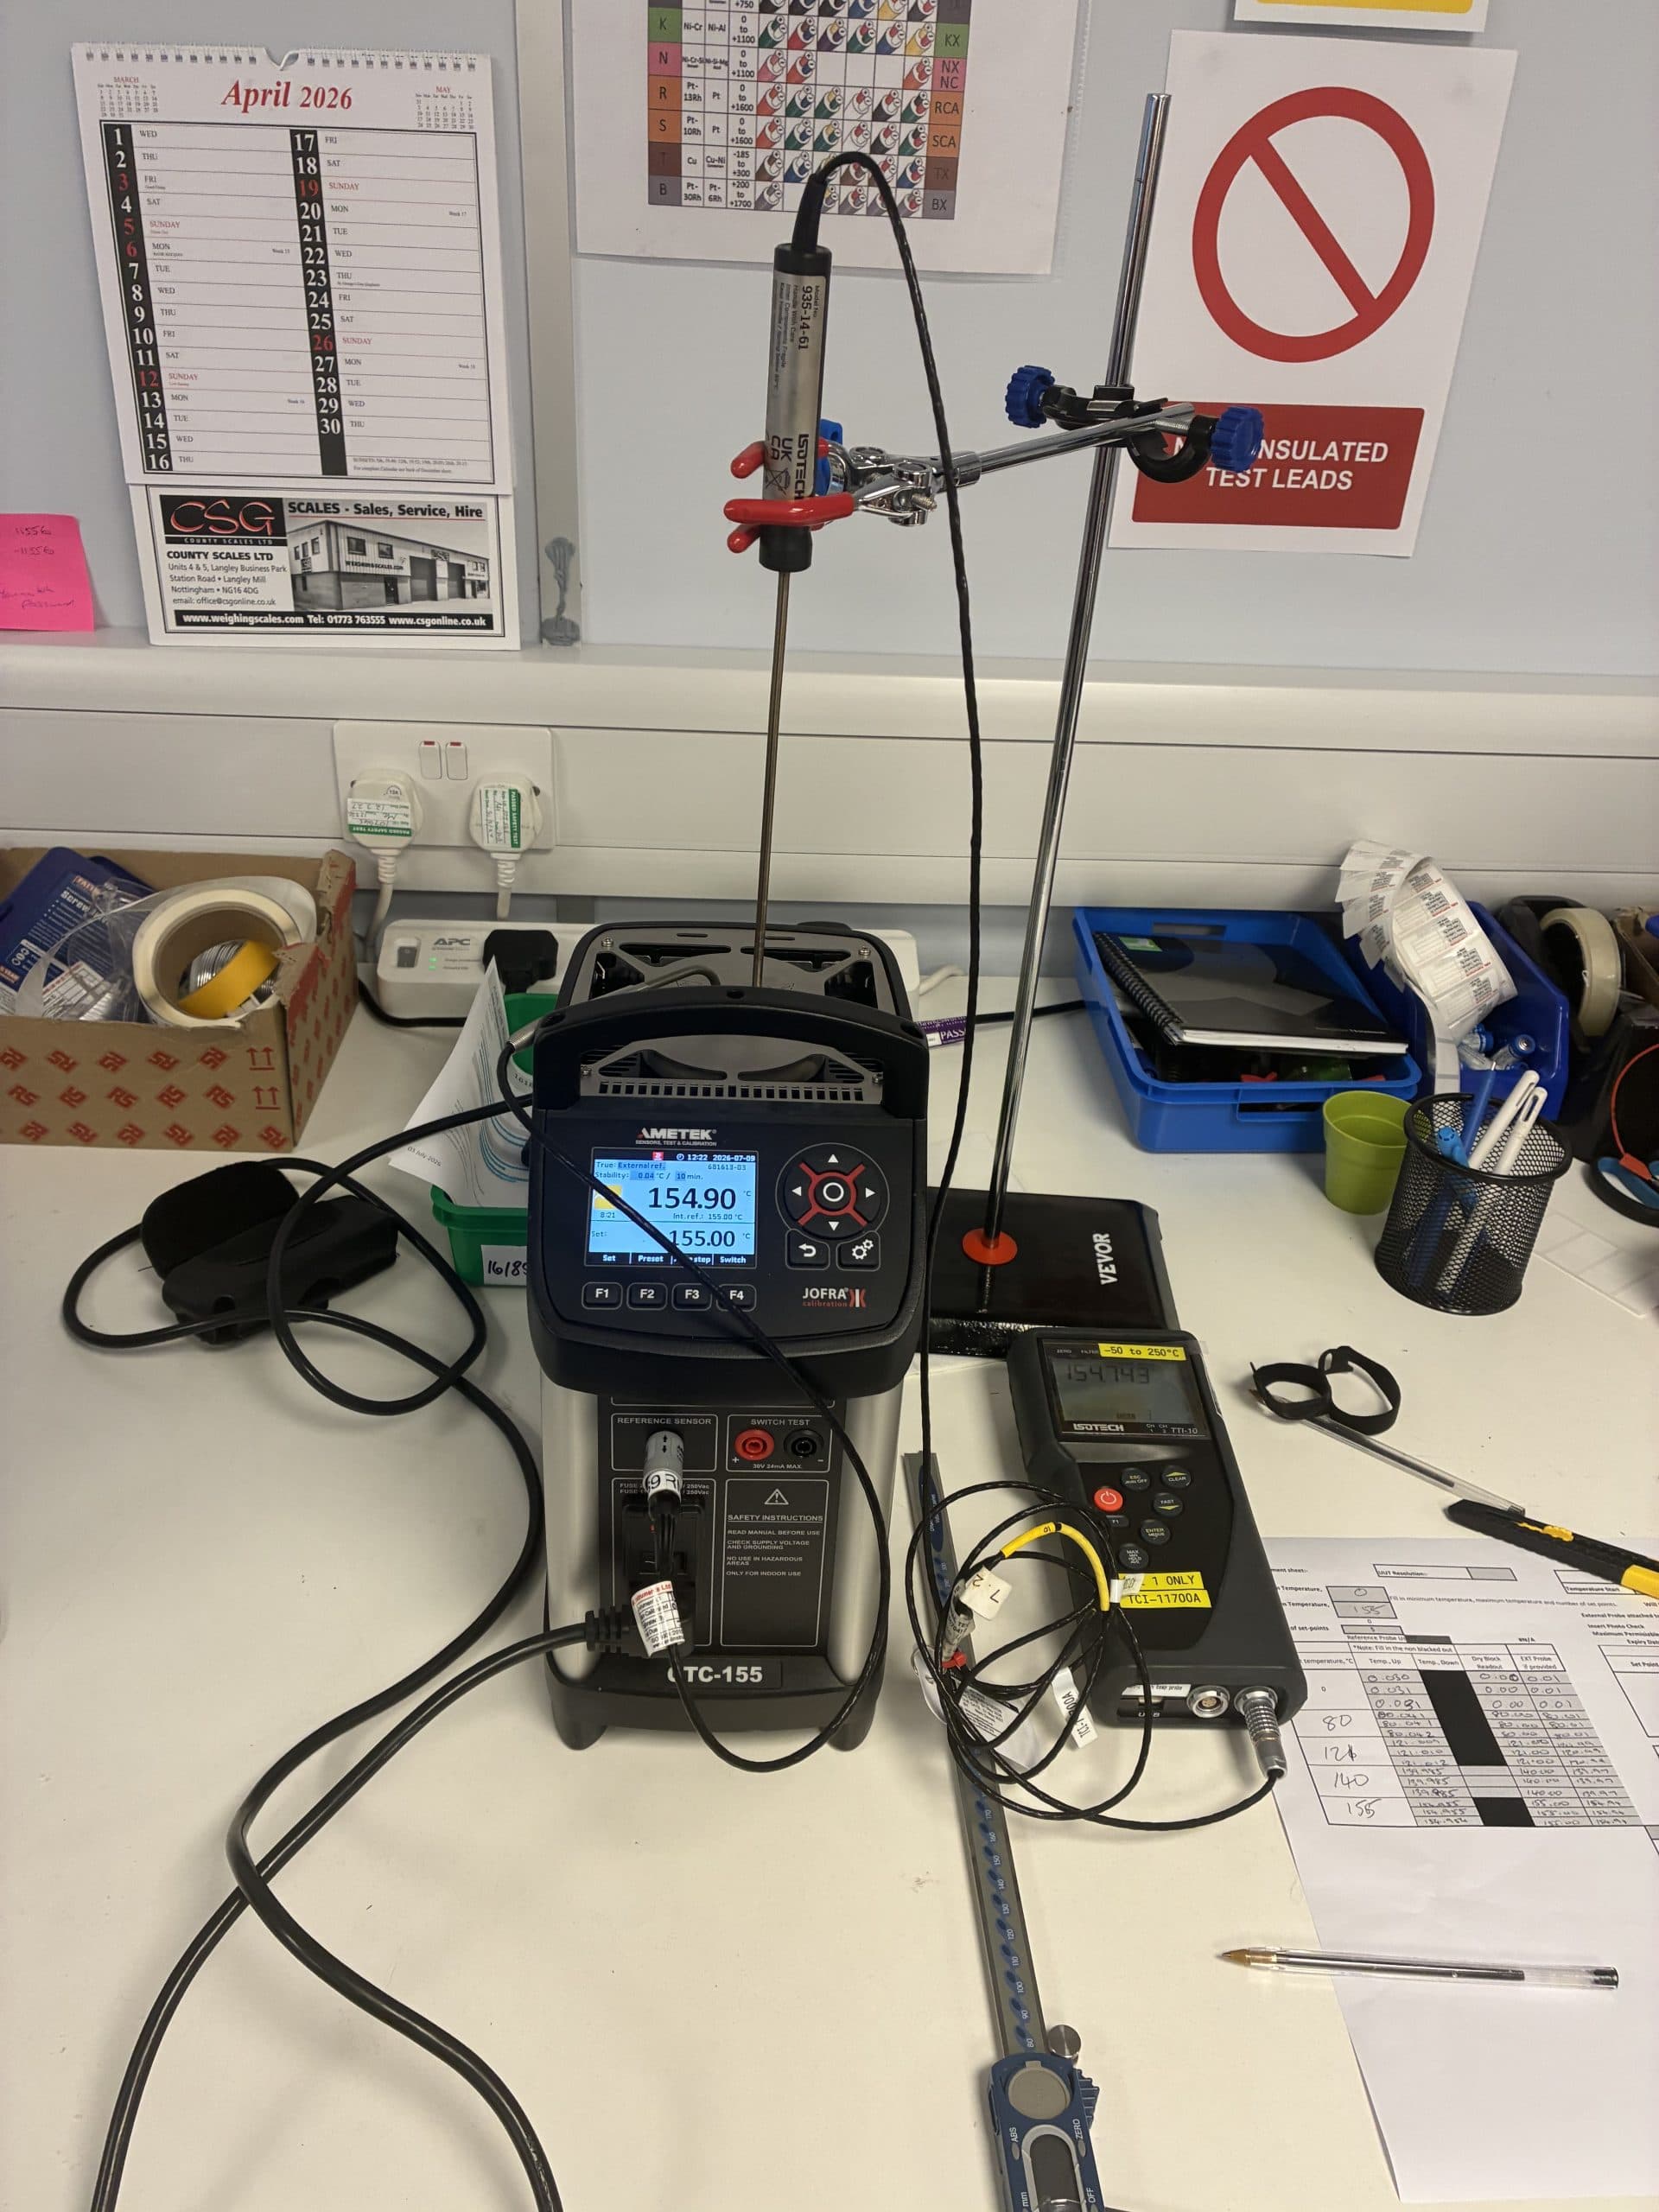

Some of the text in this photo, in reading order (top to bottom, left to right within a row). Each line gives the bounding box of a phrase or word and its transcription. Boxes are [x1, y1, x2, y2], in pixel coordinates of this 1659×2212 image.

[659, 17, 667, 30] K
[683, 22, 703, 31] Ni-Cr
[944, 34, 960, 47] KX
[659, 52, 668, 64] N
[941, 60, 960, 73] NX
[940, 76, 959, 89] NC
[220, 79, 353, 113] April 2026
[659, 86, 667, 99] R
[934, 101, 960, 115] RCA
[659, 119, 667, 132] S
[114, 128, 123, 145] 1
[294, 134, 315, 152] 17
[931, 135, 957, 148] SCA
[299, 179, 359, 197] 19 SUNDAY
[659, 183, 667, 195] B
[300, 202, 321, 219] 20
[931, 198, 948, 211] BX
[124, 218, 135, 235] 5
[303, 247, 353, 264] 22 WED
[129, 263, 170, 280] 7 TUE
[798, 285, 813, 351] 935-14-61
[131, 327, 154, 345] 10
[320, 418, 341, 435] 30
[780, 437, 793, 462] UK
[1258, 439, 1389, 462] NSULATED
[148, 454, 170, 470] 16
[794, 434, 810, 499] ISOTECH
[1205, 467, 1354, 491] TEST LEADS
[288, 501, 483, 518] SCALES Sales, Service, Hire
[170, 499, 276, 536] CSG
[166, 550, 274, 561] COUNTY SCALES LTD
[202, 563, 209, 573] 5,
[210, 564, 238, 574] Langley
[240, 564, 270, 573] Business
[171, 586, 215, 595] Nottingham
[196, 597, 276, 607] office@csgonline.co.uk
[182, 613, 487, 627] www.weighingscales.com Tel: 01773 763555 www.csgonline.co.uk
[434, 938, 471, 946] APC
[940, 1029, 965, 1040] PASS
[107, 1086, 140, 1109] RS
[637, 1127, 714, 1141] AMETEK
[649, 1187, 736, 1210] 154.90
[670, 1230, 735, 1247] 155.00
[1092, 1232, 1118, 1285] VEVOR
[594, 1287, 609, 1299] F1
[639, 1288, 654, 1300] F2
[684, 1289, 700, 1300] F3
[729, 1289, 745, 1300] F4
[802, 1287, 847, 1300] JOFRA
[1104, 1346, 1123, 1355] -50
[1147, 1347, 1179, 1357] 250°C
[674, 1417, 712, 1426] SENSOR
[1072, 1423, 1125, 1432] ISOTECH
[1152, 1575, 1195, 1586] 1 ONLY
[1128, 1593, 1202, 1605] TCI-11700A
[1323, 1714, 1352, 1731] 80
[1334, 1771, 1370, 1789] 140
[1006, 1929, 1014, 1940] 120
[1021, 2009, 1028, 2019] 90
[1009, 2126, 1019, 2143] ABS
[1072, 2119, 1084, 2140] ZERO
[1021, 2191, 1028, 2207] mm
[1086, 2187, 1096, 2203] OFF
